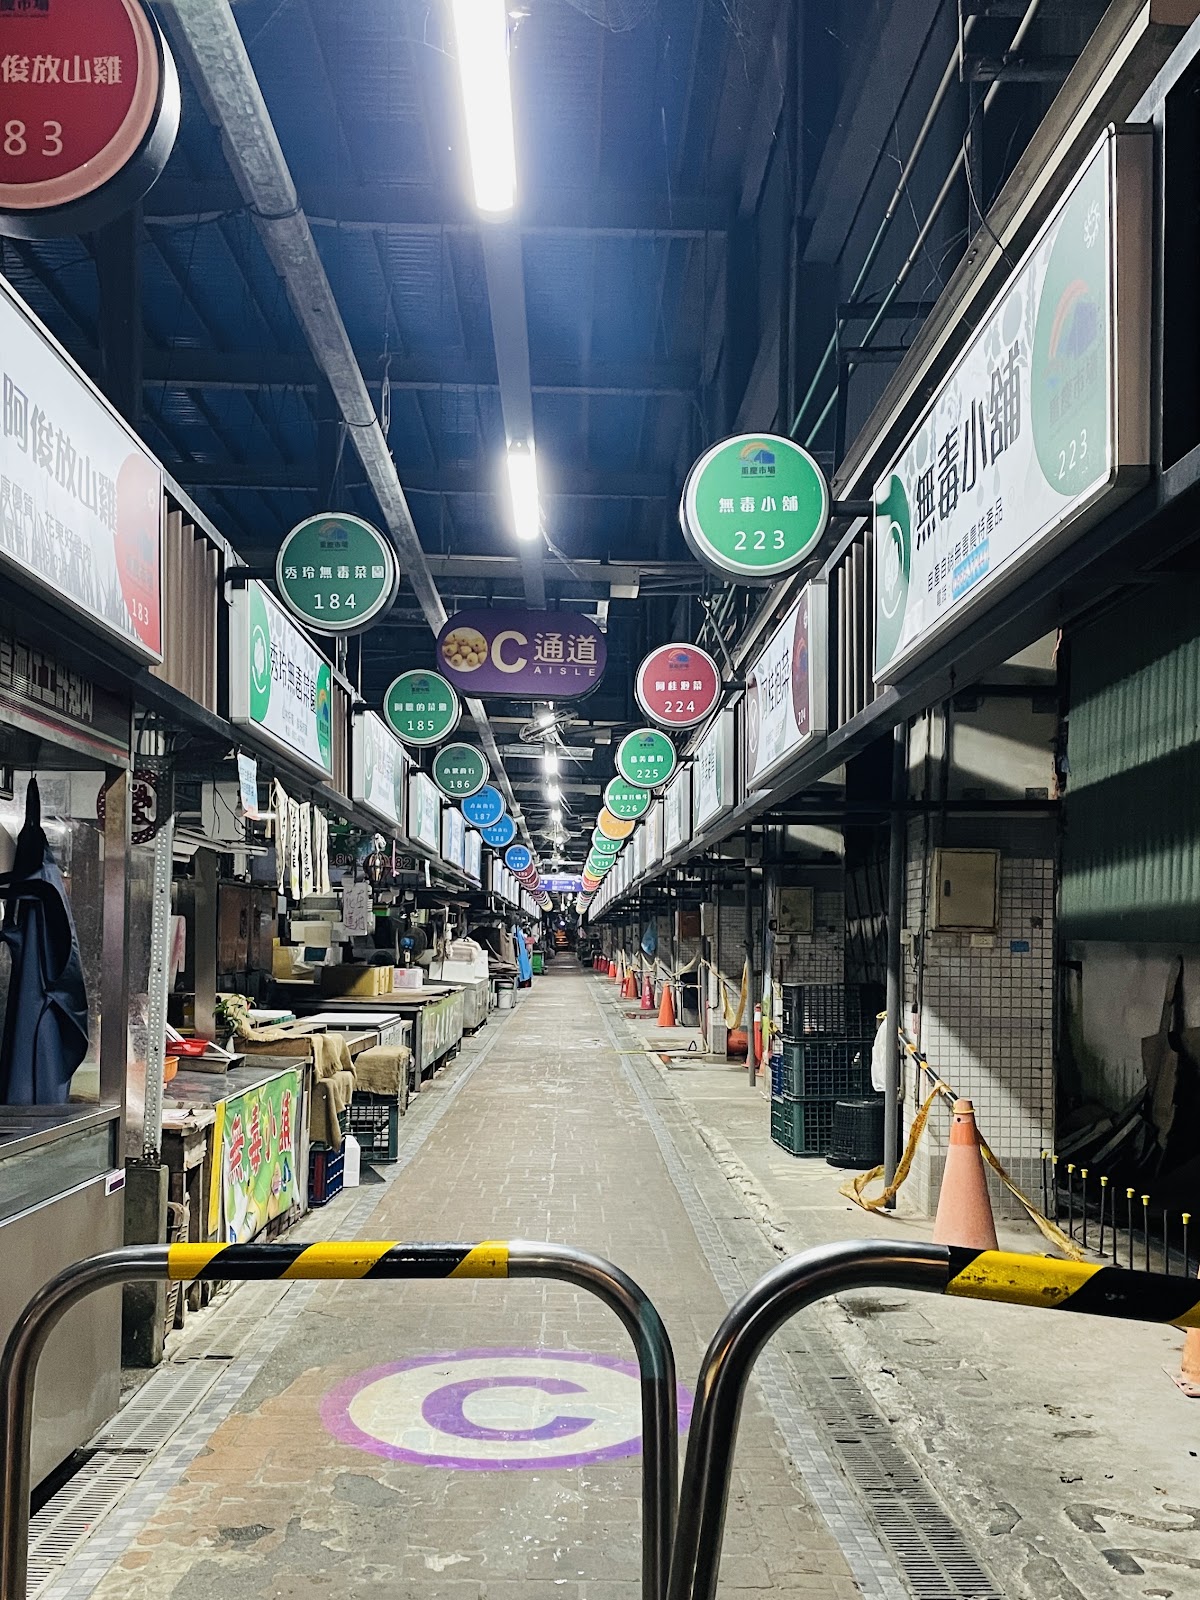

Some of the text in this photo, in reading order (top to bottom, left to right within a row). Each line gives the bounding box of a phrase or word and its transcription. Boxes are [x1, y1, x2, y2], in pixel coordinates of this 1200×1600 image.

[1, 54, 122, 84] 俊放山雞
[3, 120, 63, 156] 83
[3, 371, 118, 533] 阿俊放山雞
[916, 340, 1021, 551] 無毒小舖
[1058, 428, 1088, 480] 223
[719, 495, 799, 513] 無毒小舖
[734, 530, 785, 551] 223
[285, 566, 384, 579] 秀玲無毒菜園
[131, 597, 150, 626] 183
[314, 593, 357, 609] 184
[491, 630, 598, 674] C 通道
[533, 666, 596, 677] AISLE
[664, 701, 695, 712] 224
[407, 720, 434, 731] 185
[636, 769, 659, 778] 225
[450, 780, 470, 789] 186
[421, 1376, 596, 1442] C
